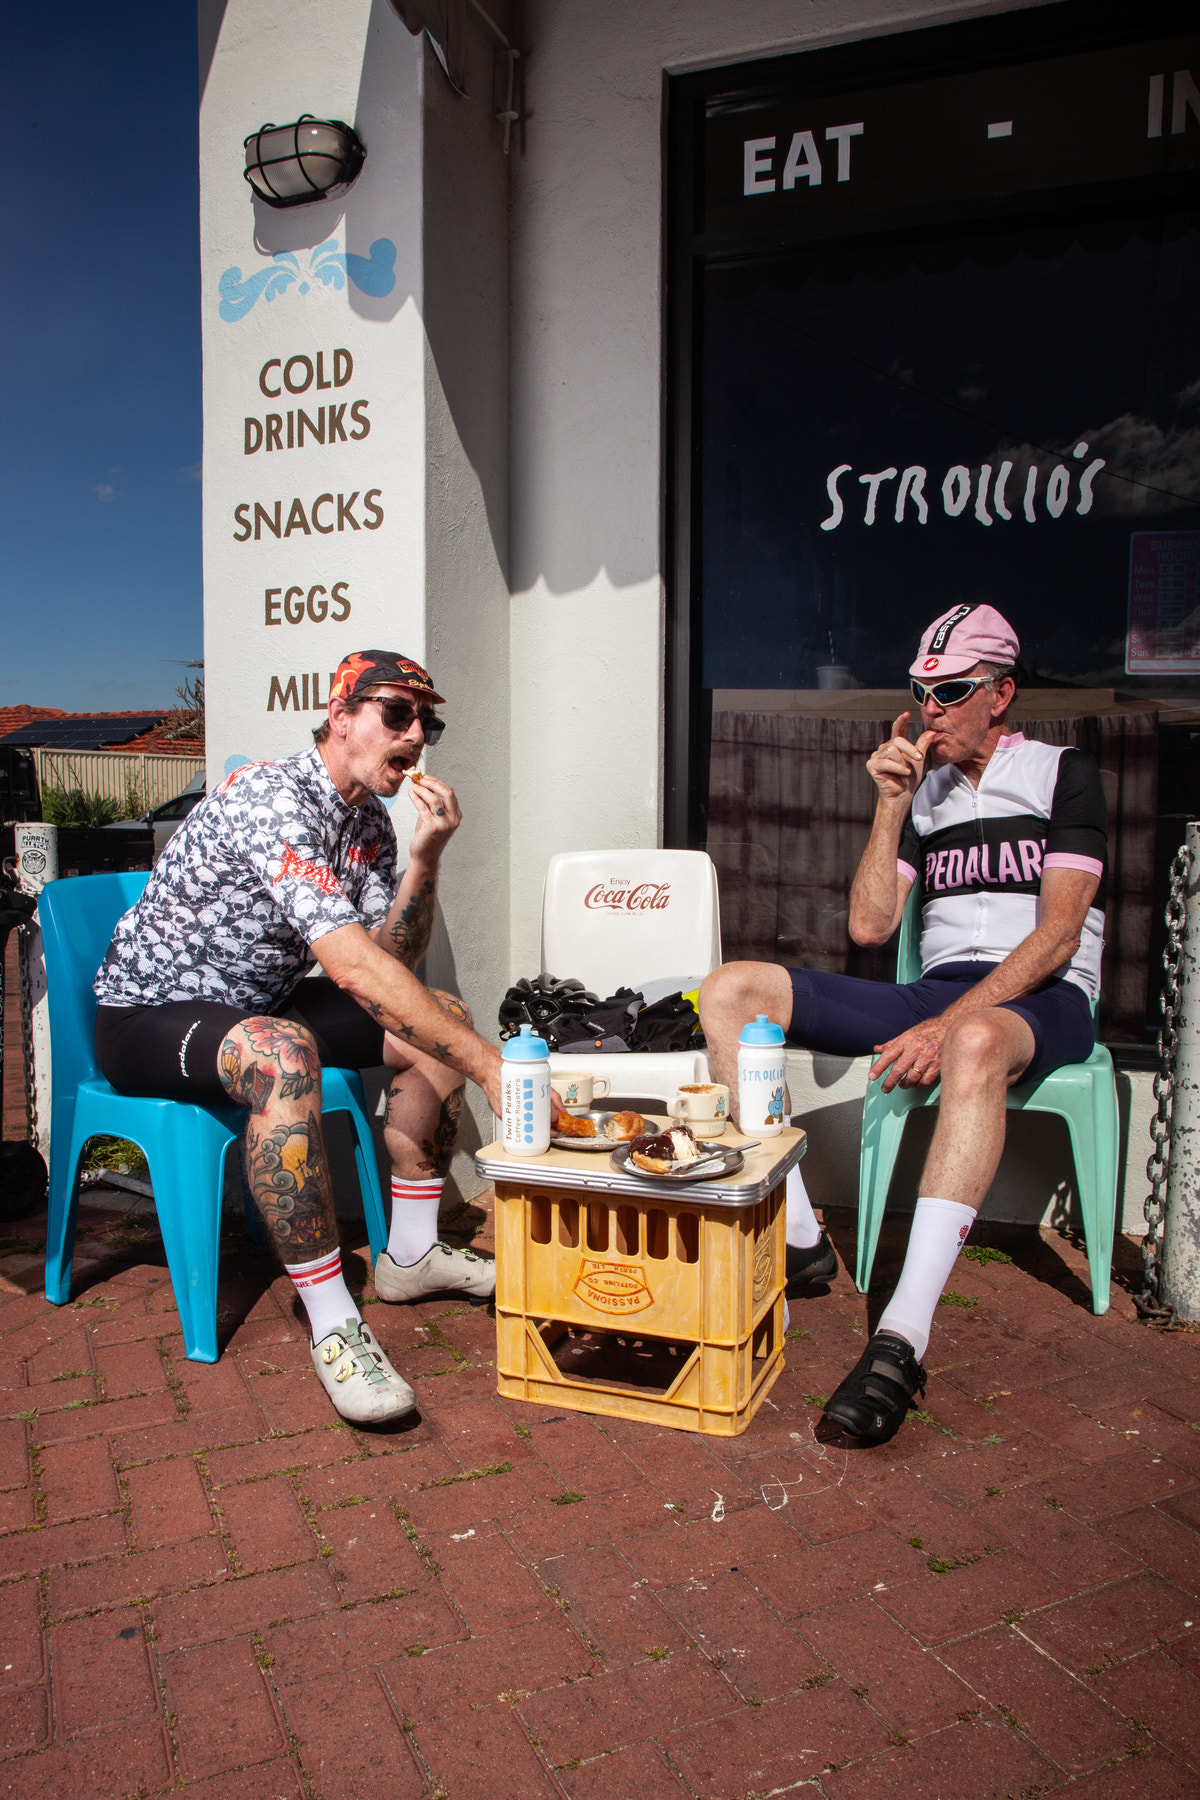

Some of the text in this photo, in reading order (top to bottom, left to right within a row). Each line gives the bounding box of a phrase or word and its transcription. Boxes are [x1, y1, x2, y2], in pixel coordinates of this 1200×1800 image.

[743, 122, 864, 196] EAT
[258, 348, 353, 398] COLD
[244, 399, 371, 455] DRINKS
[232, 488, 385, 542] SNACKS
[264, 581, 352, 626] EGGS
[267, 671, 335, 712] MIL
[610, 877, 631, 886] Enjoy
[925, 838, 1047, 892] PEDALAR
[613, 1265, 637, 1274] PERTH
[587, 1288, 641, 1307] PASSIONA
